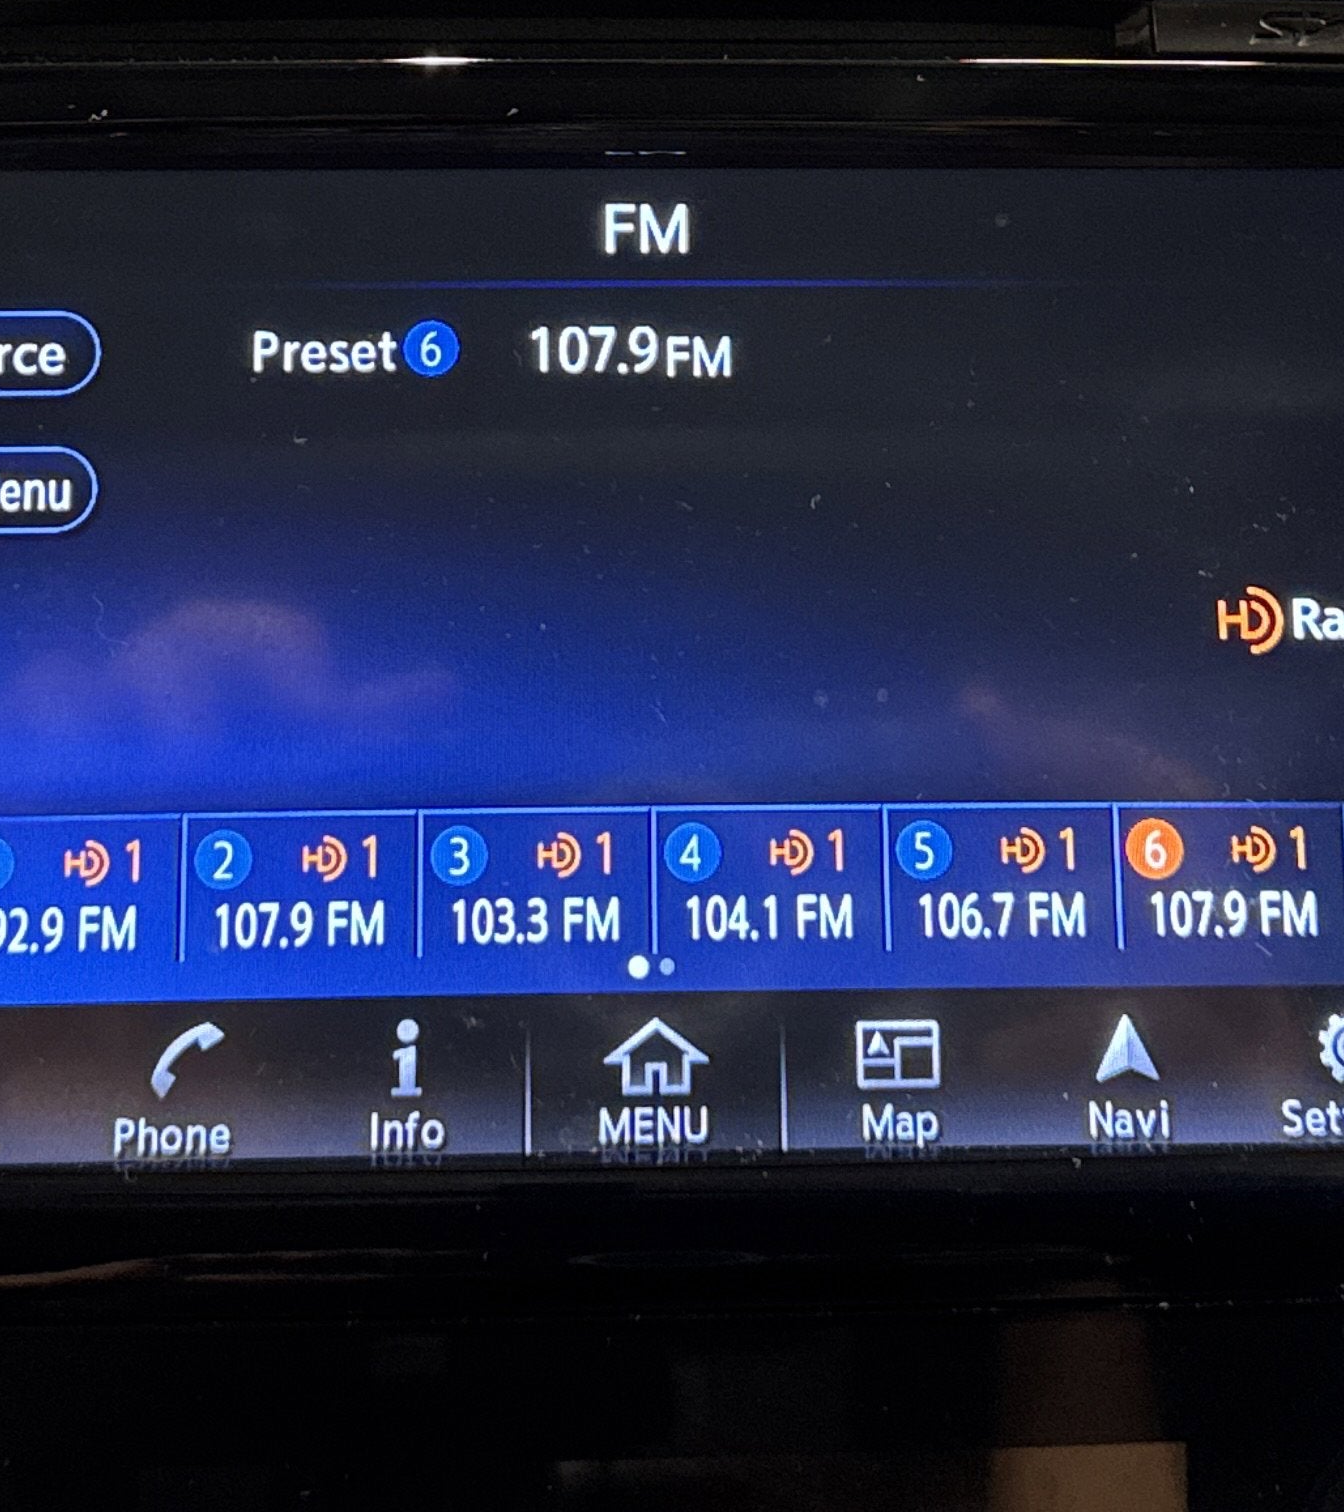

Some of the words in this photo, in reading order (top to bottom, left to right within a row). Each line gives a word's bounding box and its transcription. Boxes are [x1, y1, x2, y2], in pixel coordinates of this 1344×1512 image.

[604, 203, 690, 255] FM
[252, 330, 397, 373] Preset
[420, 331, 442, 367] 6
[125, 839, 141, 883] 1
[212, 839, 233, 880] 2
[362, 834, 377, 879] 1
[449, 836, 470, 876] 3
[596, 831, 611, 875] 1
[679, 833, 702, 871] 4
[827, 828, 844, 872] 1
[914, 831, 935, 871] 5
[1059, 826, 1075, 871] 1
[1143, 828, 1169, 870] 6
[1289, 825, 1307, 870] 1
[78, 905, 137, 952] FM
[215, 901, 314, 949] 107.9
[327, 899, 385, 947] FM
[452, 897, 549, 945] 103.3
[563, 896, 620, 943] FM
[686, 894, 778, 941] 104.1
[796, 893, 853, 940] FM
[918, 891, 1015, 939] 106.7
[1028, 891, 1086, 938] FM
[1150, 889, 1248, 939] 107.9
[1258, 889, 1318, 937] FM
[113, 1116, 231, 1156] Phone
[370, 1110, 445, 1151] Info
[598, 1105, 708, 1146] MENU
[862, 1102, 939, 1149] Map
[1088, 1099, 1170, 1139] Navi
